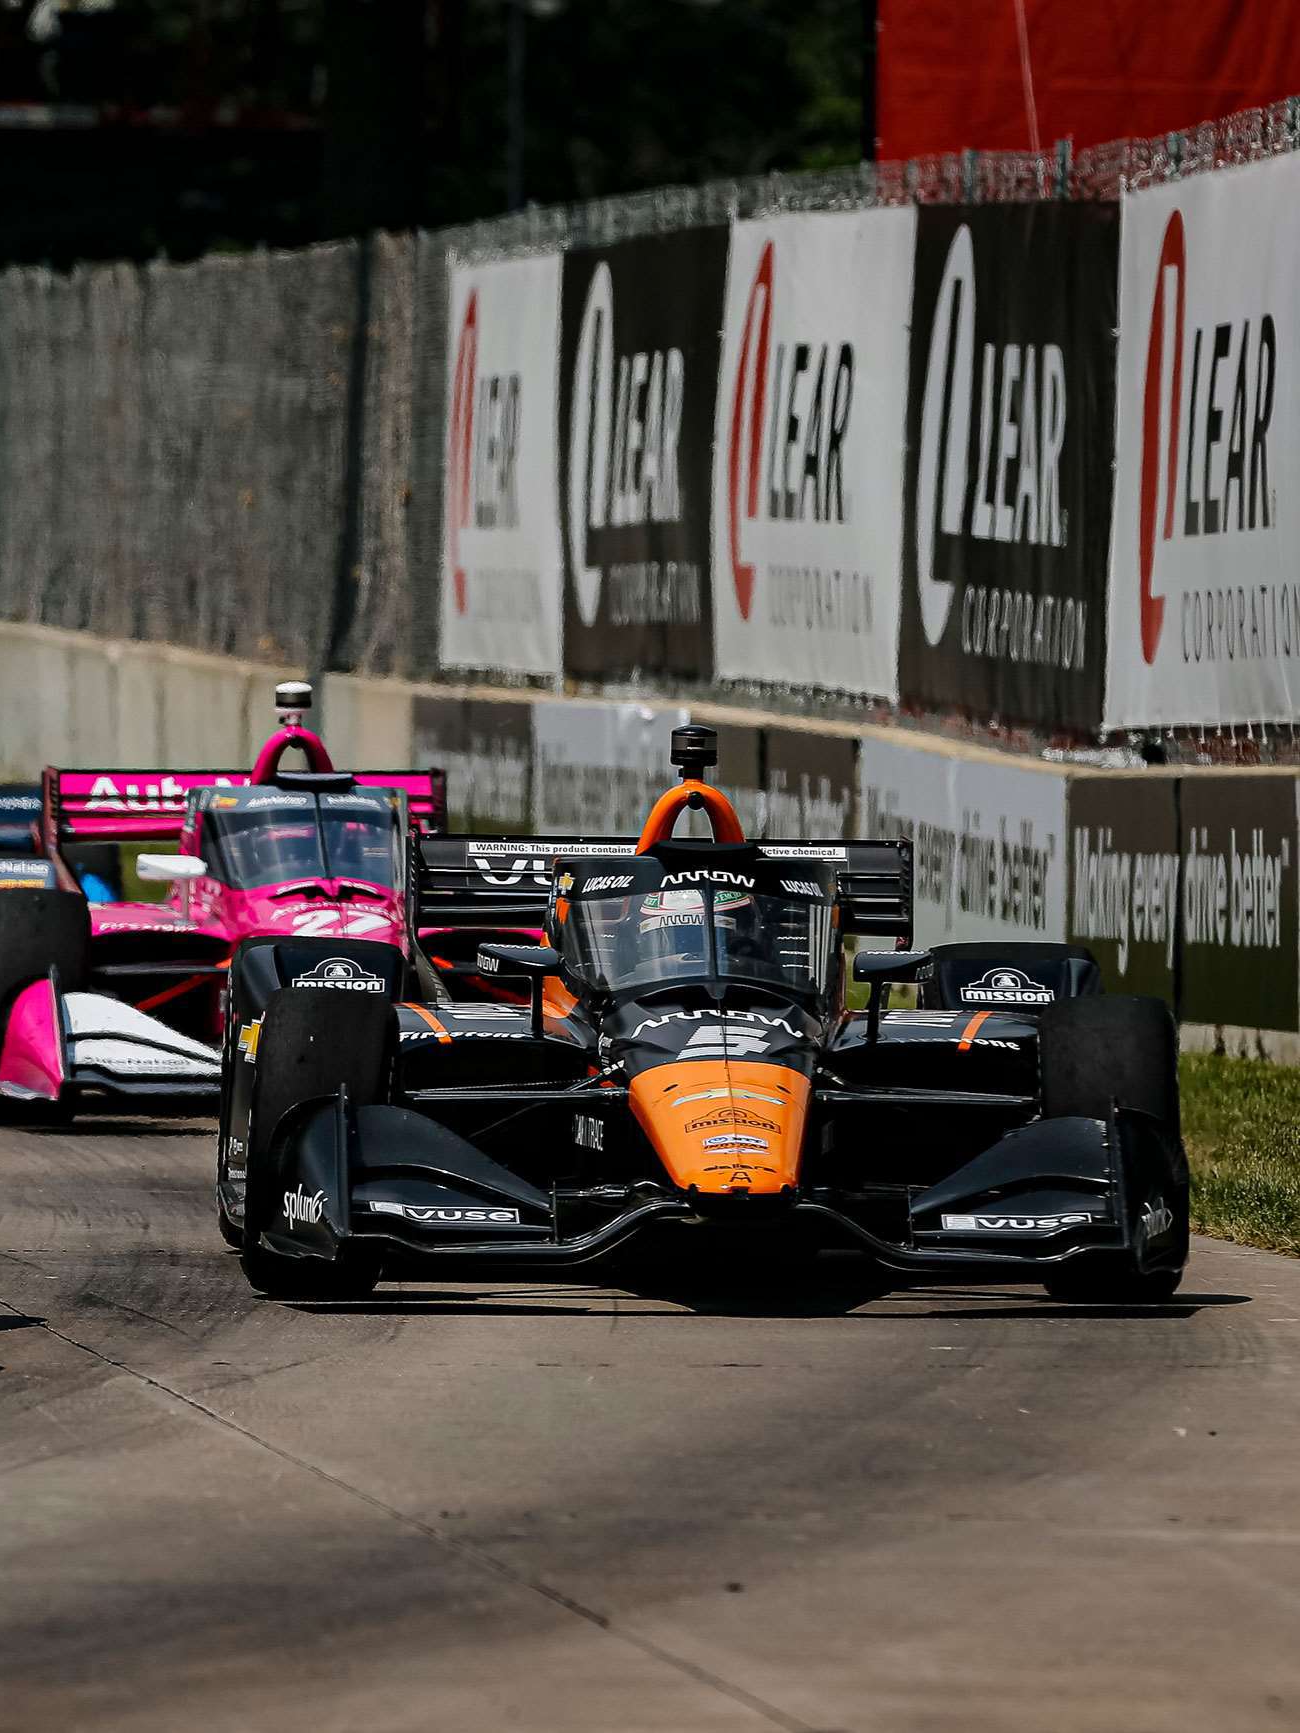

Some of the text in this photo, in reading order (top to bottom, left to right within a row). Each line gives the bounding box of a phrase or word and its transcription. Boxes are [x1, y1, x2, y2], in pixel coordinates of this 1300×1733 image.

[769, 342, 853, 522] LEAR
[1184, 313, 1276, 536] LEAR
[970, 343, 1067, 547] LEAR
[476, 843, 528, 852] WARNING:
[530, 844, 550, 853] This
[553, 845, 589, 855] product
[792, 847, 840, 856] chemical.
[581, 875, 634, 894] LUCAS OIL
[660, 870, 756, 888] ARROW
[1132, 851, 1180, 970] every
[1184, 827, 1227, 946] drive
[292, 909, 392, 937] 27
[965, 990, 1051, 1002] mission
[399, 1031, 527, 1042] Firestone
[675, 1025, 769, 1061] 5
[691, 1117, 776, 1130] mission
[703, 1163, 777, 1174] dallara
